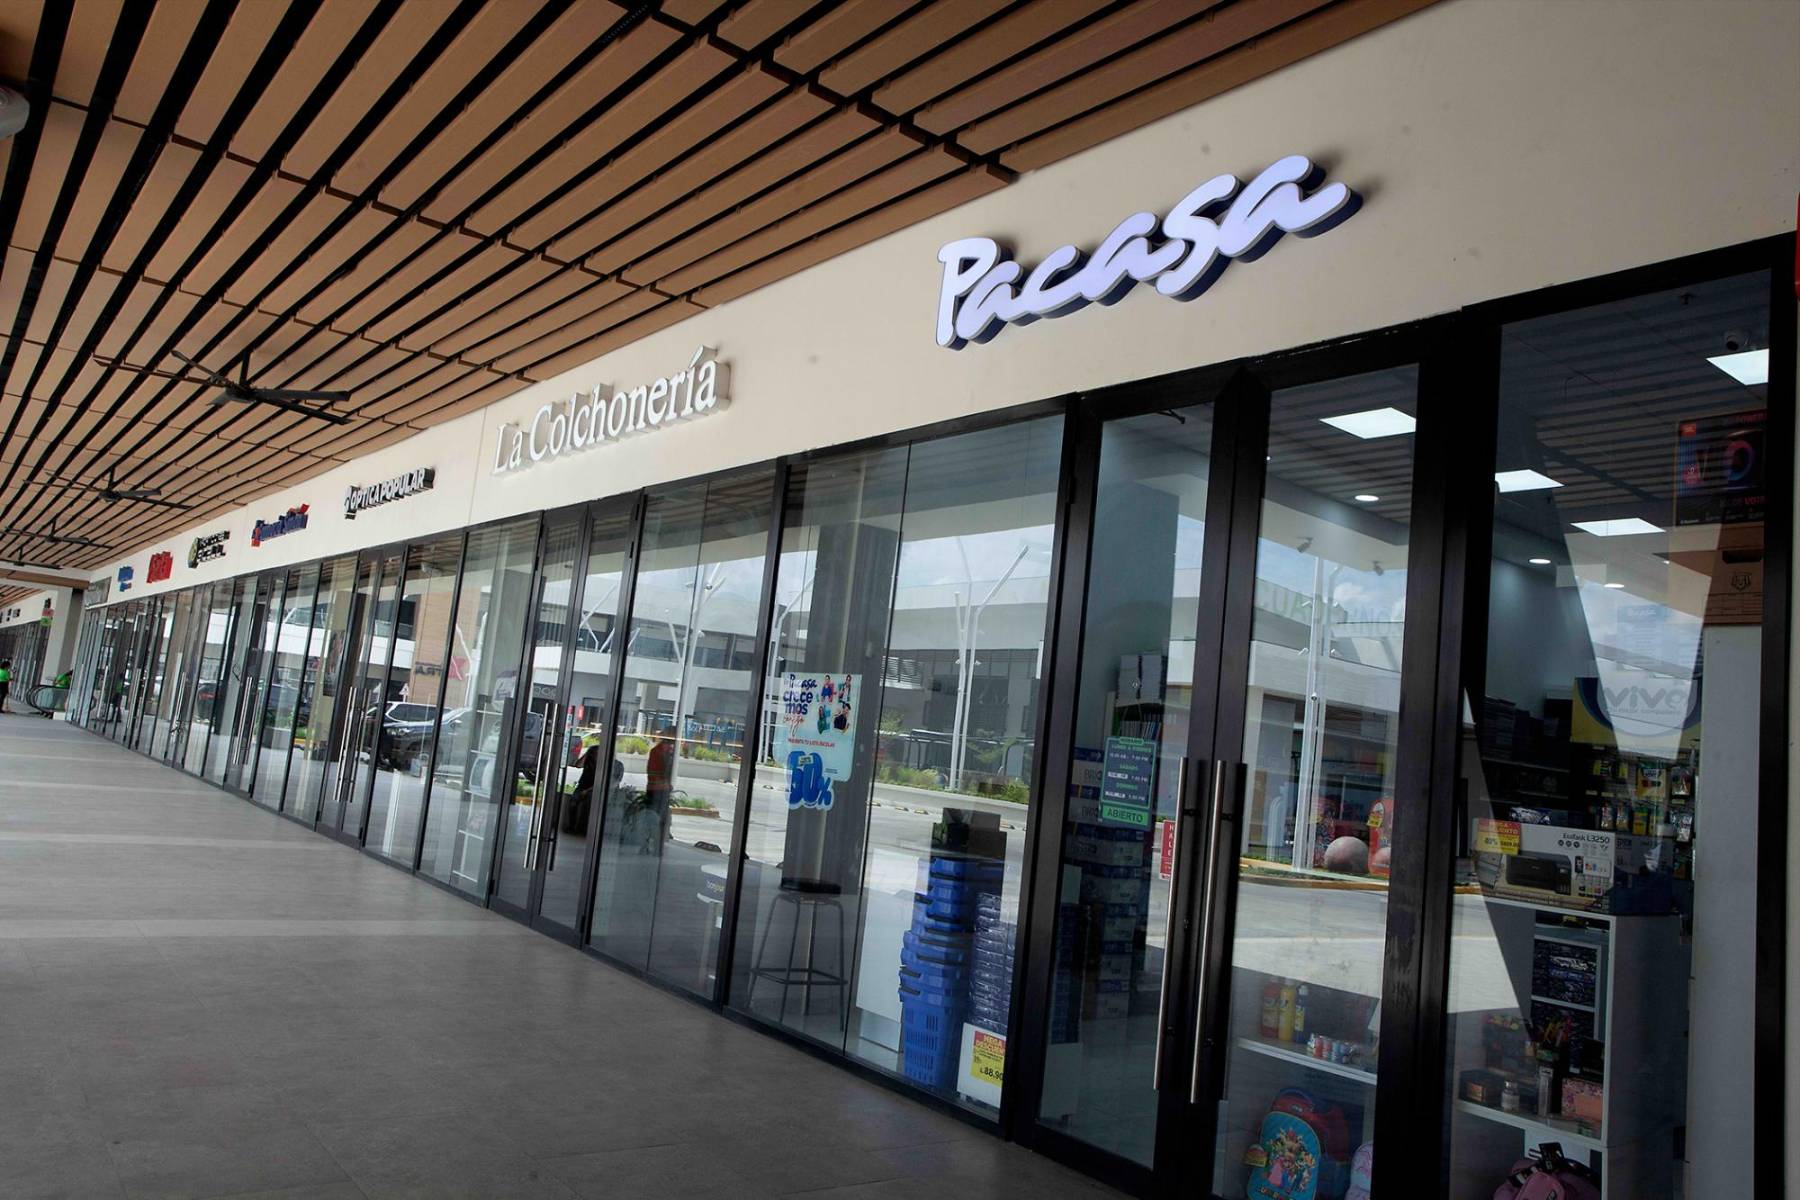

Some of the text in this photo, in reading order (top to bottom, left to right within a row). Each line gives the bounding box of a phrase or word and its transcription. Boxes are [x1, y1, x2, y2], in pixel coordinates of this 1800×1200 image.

[936, 155, 1351, 347] Pacasa
[493, 345, 718, 474] La Colchonería
[381, 468, 426, 501] POPULAR
[789, 674, 818, 690] Pasa
[1107, 808, 1143, 823] ABIERTO
[1586, 833, 1610, 844] L3250
